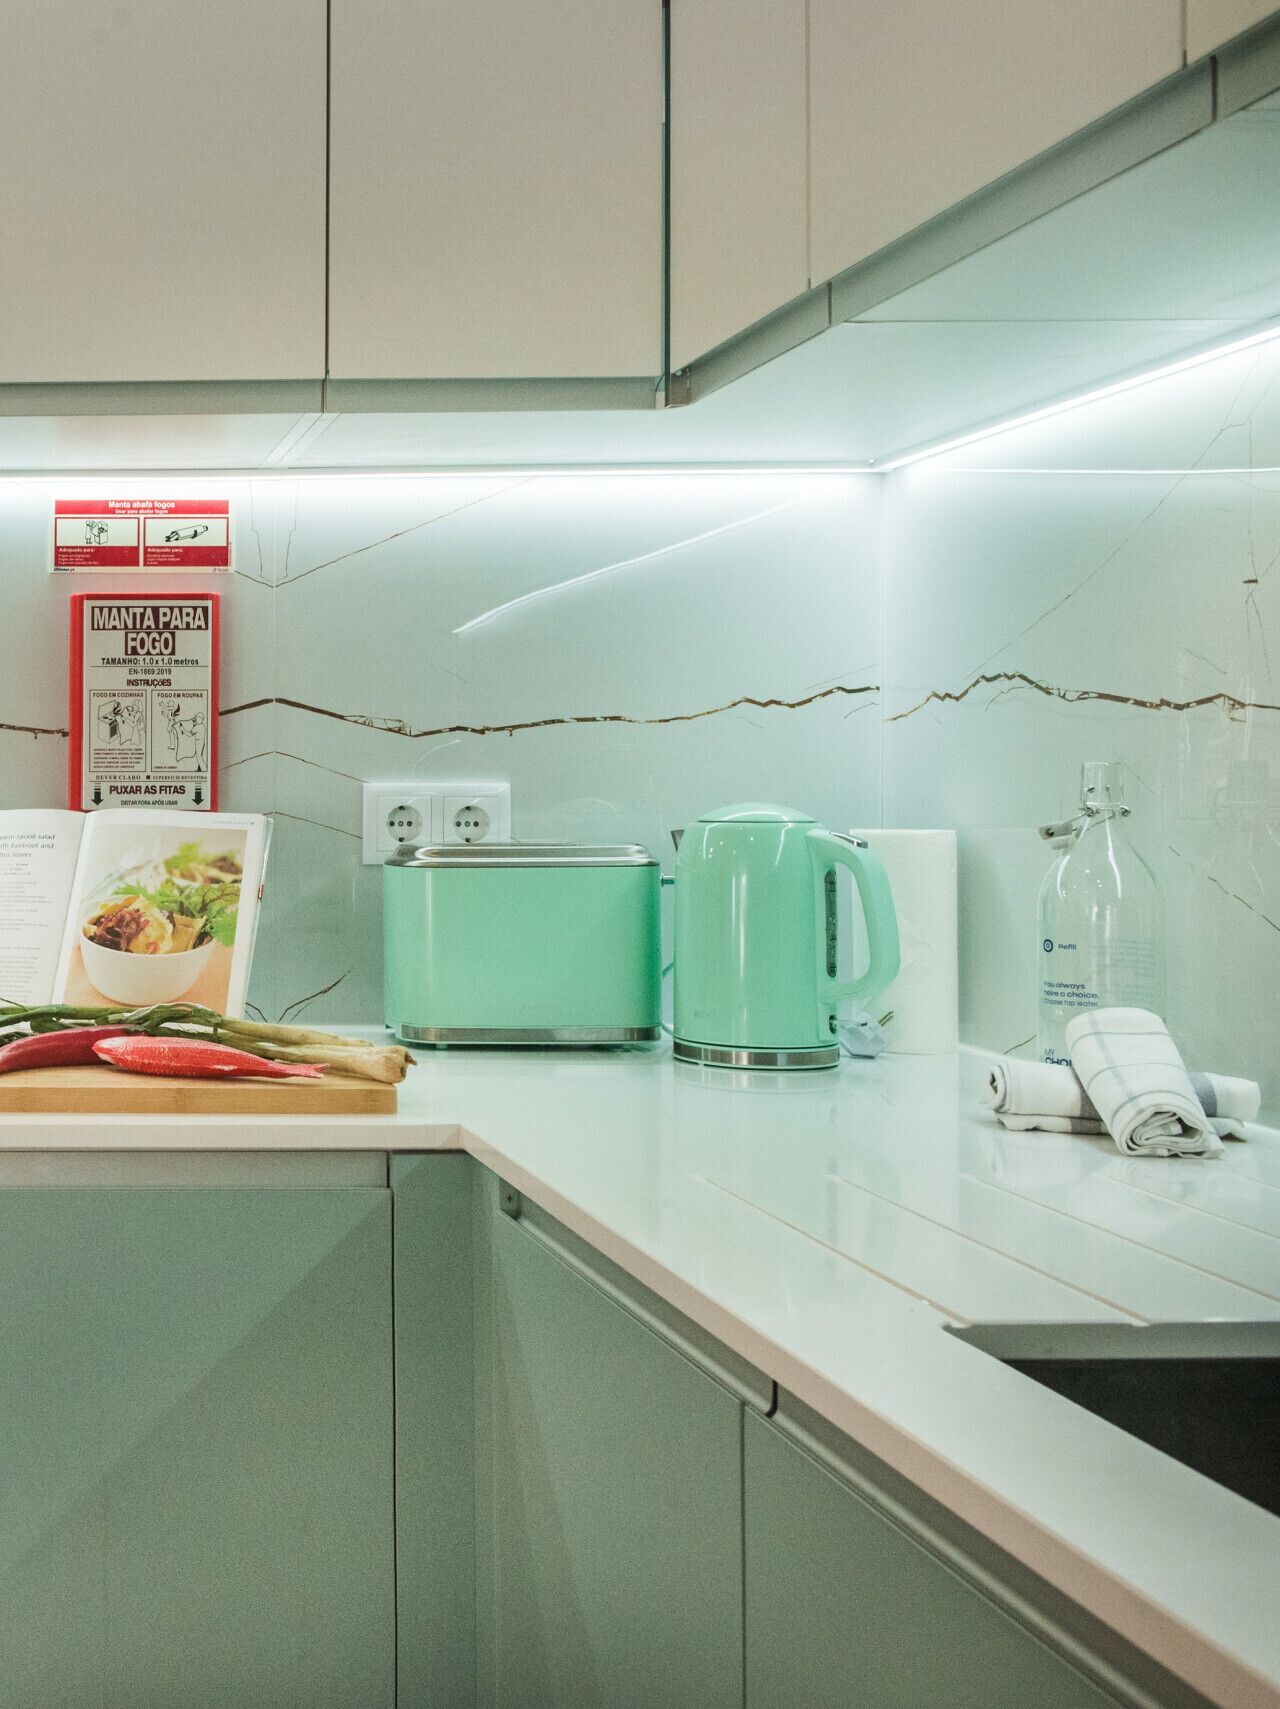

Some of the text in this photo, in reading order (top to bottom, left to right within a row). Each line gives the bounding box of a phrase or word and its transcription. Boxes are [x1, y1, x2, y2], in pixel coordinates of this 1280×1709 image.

[108, 500, 175, 510] Manta abafa fogos
[93, 607, 206, 629] MANTA PARA
[127, 632, 173, 655] FOGO
[109, 785, 186, 795] PUXAR AS FITAS
[17, 832, 36, 840] ravioli
[38, 832, 56, 840] salad
[1056, 982, 1086, 990] always
[1044, 989, 1059, 997] have
[1066, 991, 1100, 999] choice.
